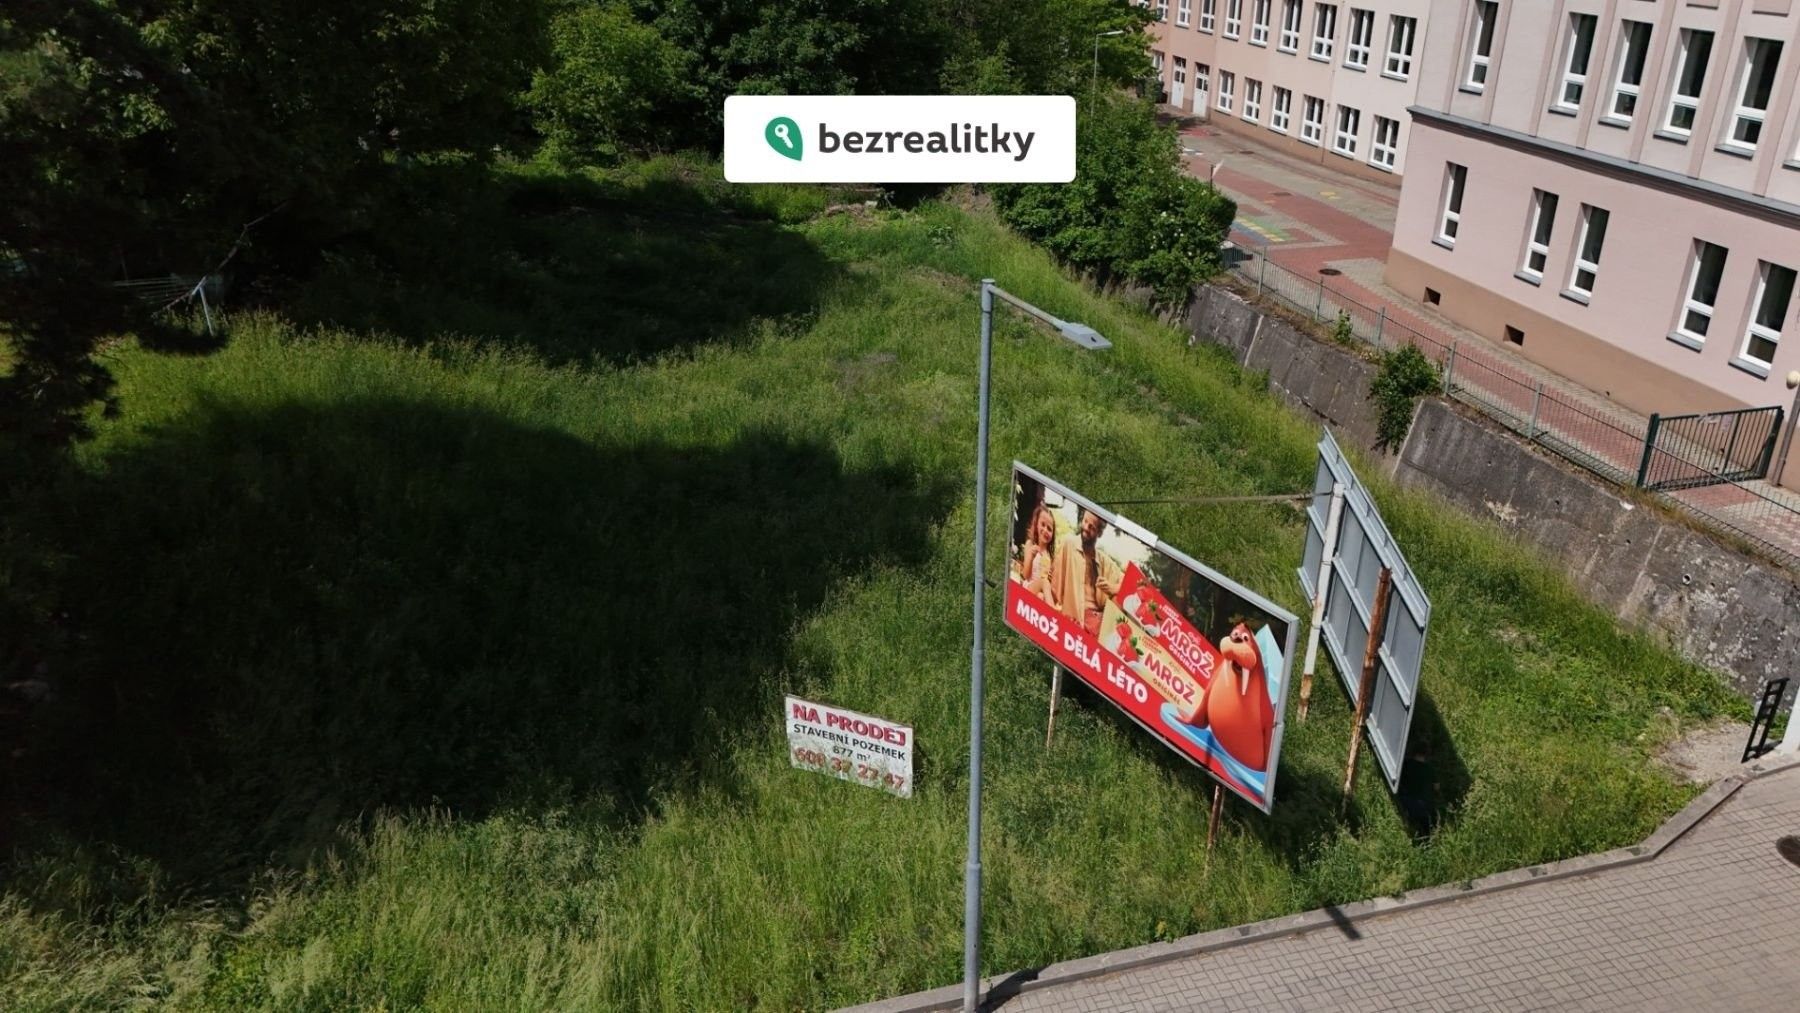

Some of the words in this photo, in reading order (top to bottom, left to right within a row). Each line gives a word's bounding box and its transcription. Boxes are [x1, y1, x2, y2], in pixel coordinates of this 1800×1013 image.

[1016, 598, 1059, 642] MROŽ
[1064, 629, 1102, 673] DĚLÁ
[1107, 664, 1148, 704] LÉTO
[1161, 618, 1213, 678] MROŽ
[1145, 653, 1195, 705] MROŽ
[793, 703, 821, 724] NA
[826, 712, 906, 746] PRODEJ
[794, 724, 849, 745] STAVEBNÍ
[853, 738, 905, 760] POZEMEK
